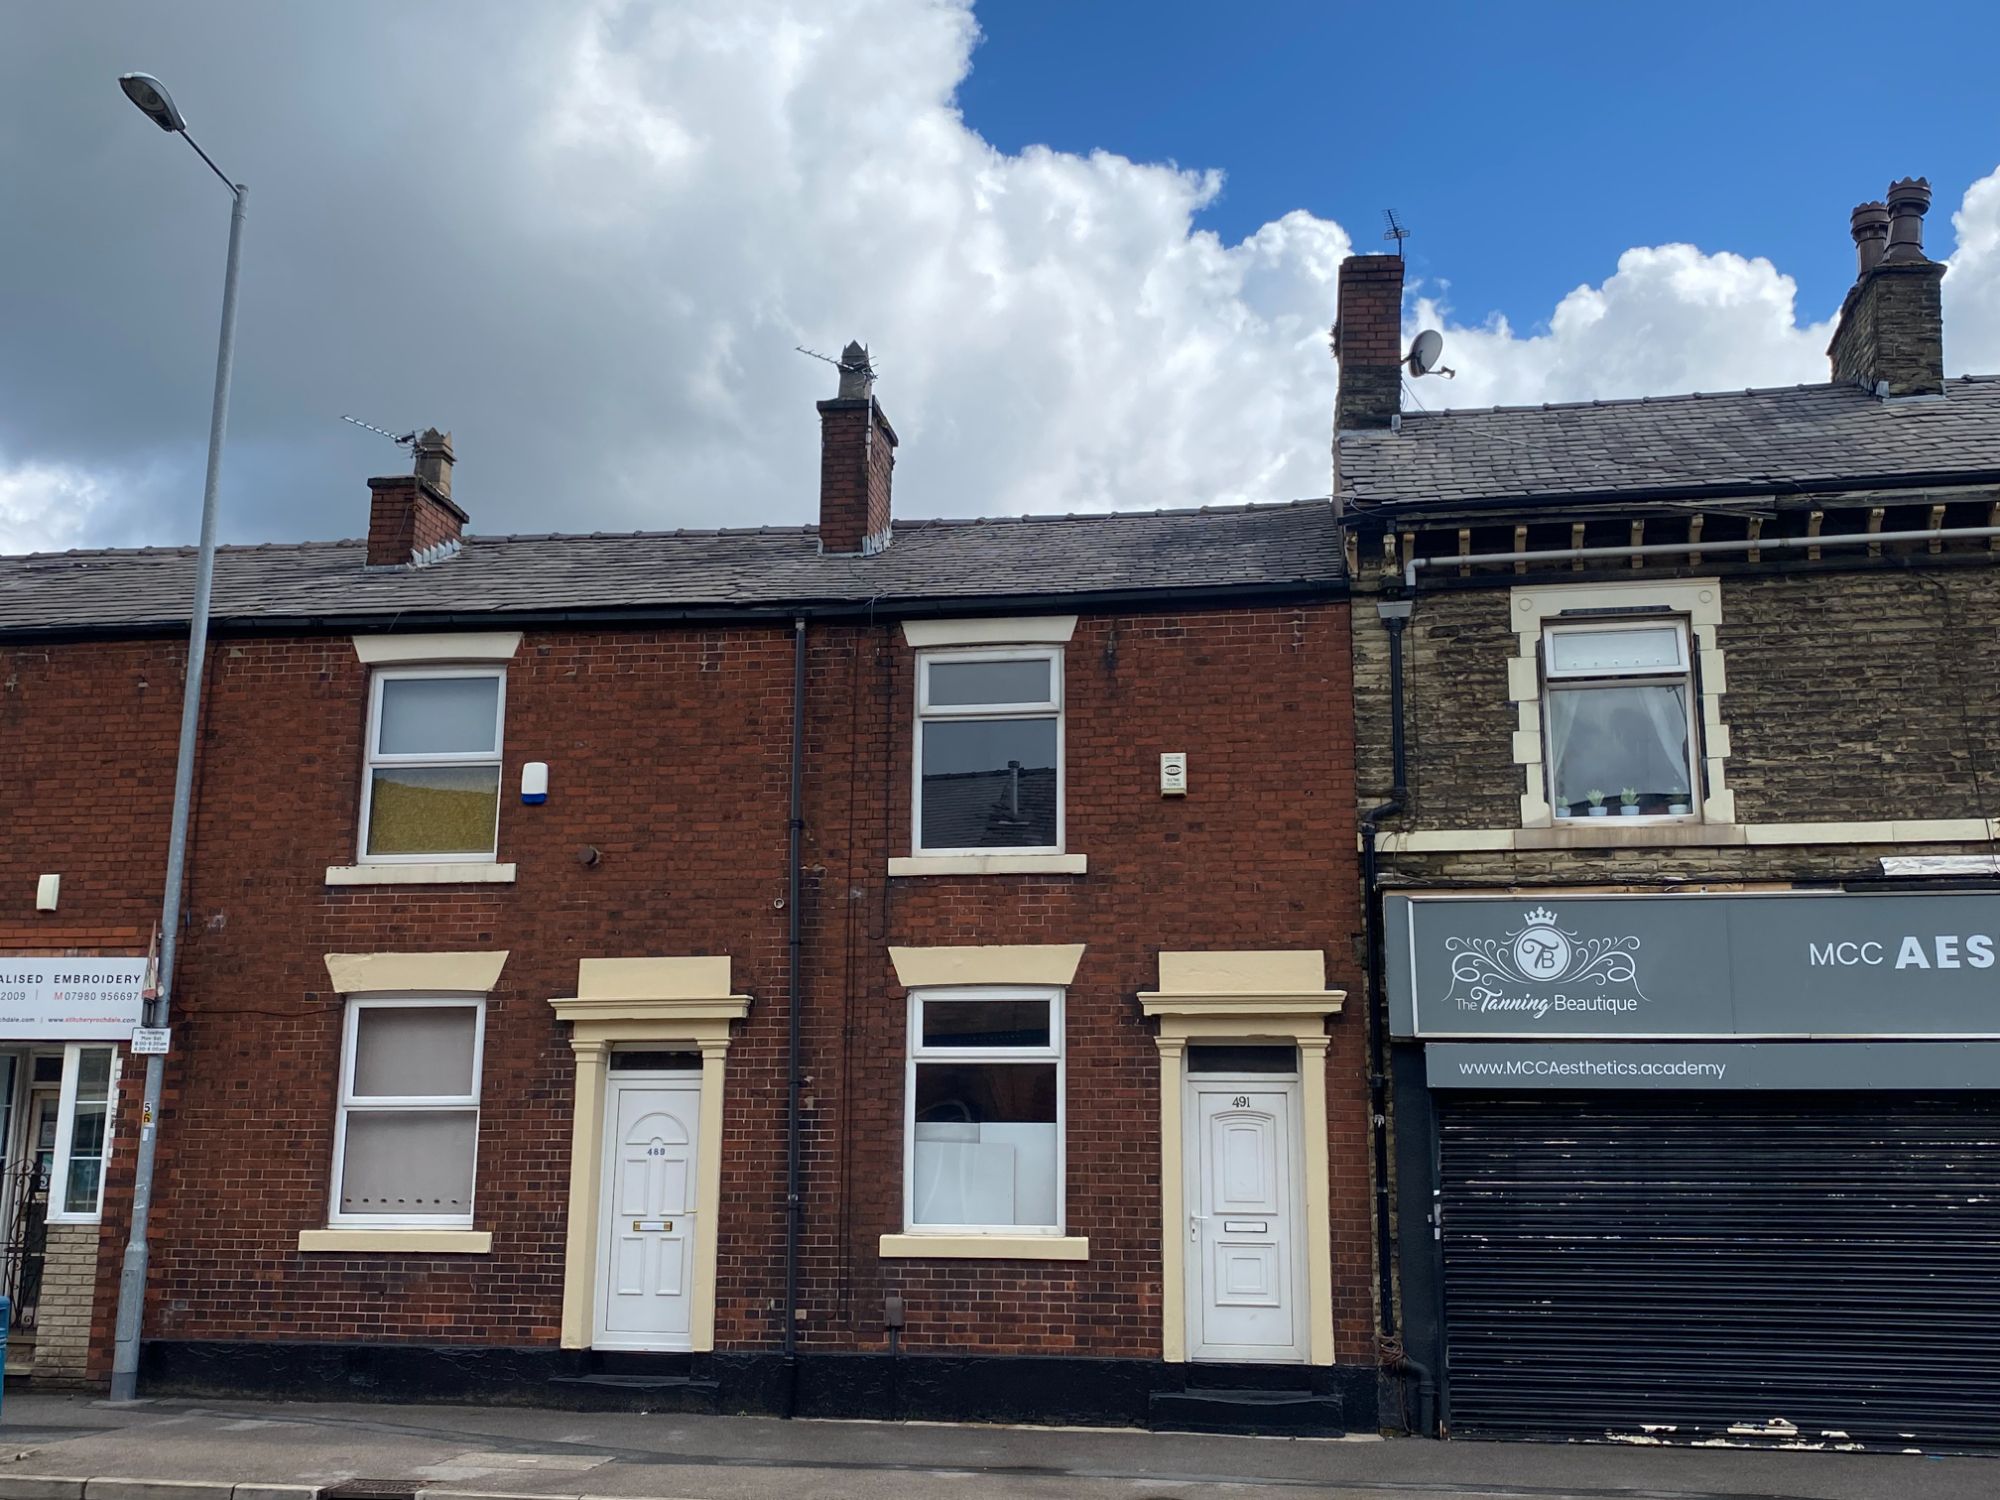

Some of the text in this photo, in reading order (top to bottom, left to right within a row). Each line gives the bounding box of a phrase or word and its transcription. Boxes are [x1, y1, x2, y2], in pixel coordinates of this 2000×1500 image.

[1521, 938, 1559, 969] TB
[1809, 934, 1995, 969] MCC AES
[54, 974, 141, 984] EMBROIDERY
[100, 991, 139, 1001] 956697
[1455, 986, 1638, 1019] The Tanning Beautique
[1459, 1060, 1726, 1079] www.MCCAesthetics.academy
[144, 1102, 150, 1112] 5
[1232, 1096, 1250, 1108] 491
[144, 1113, 150, 1122] 6
[647, 1148, 665, 1156] 489
